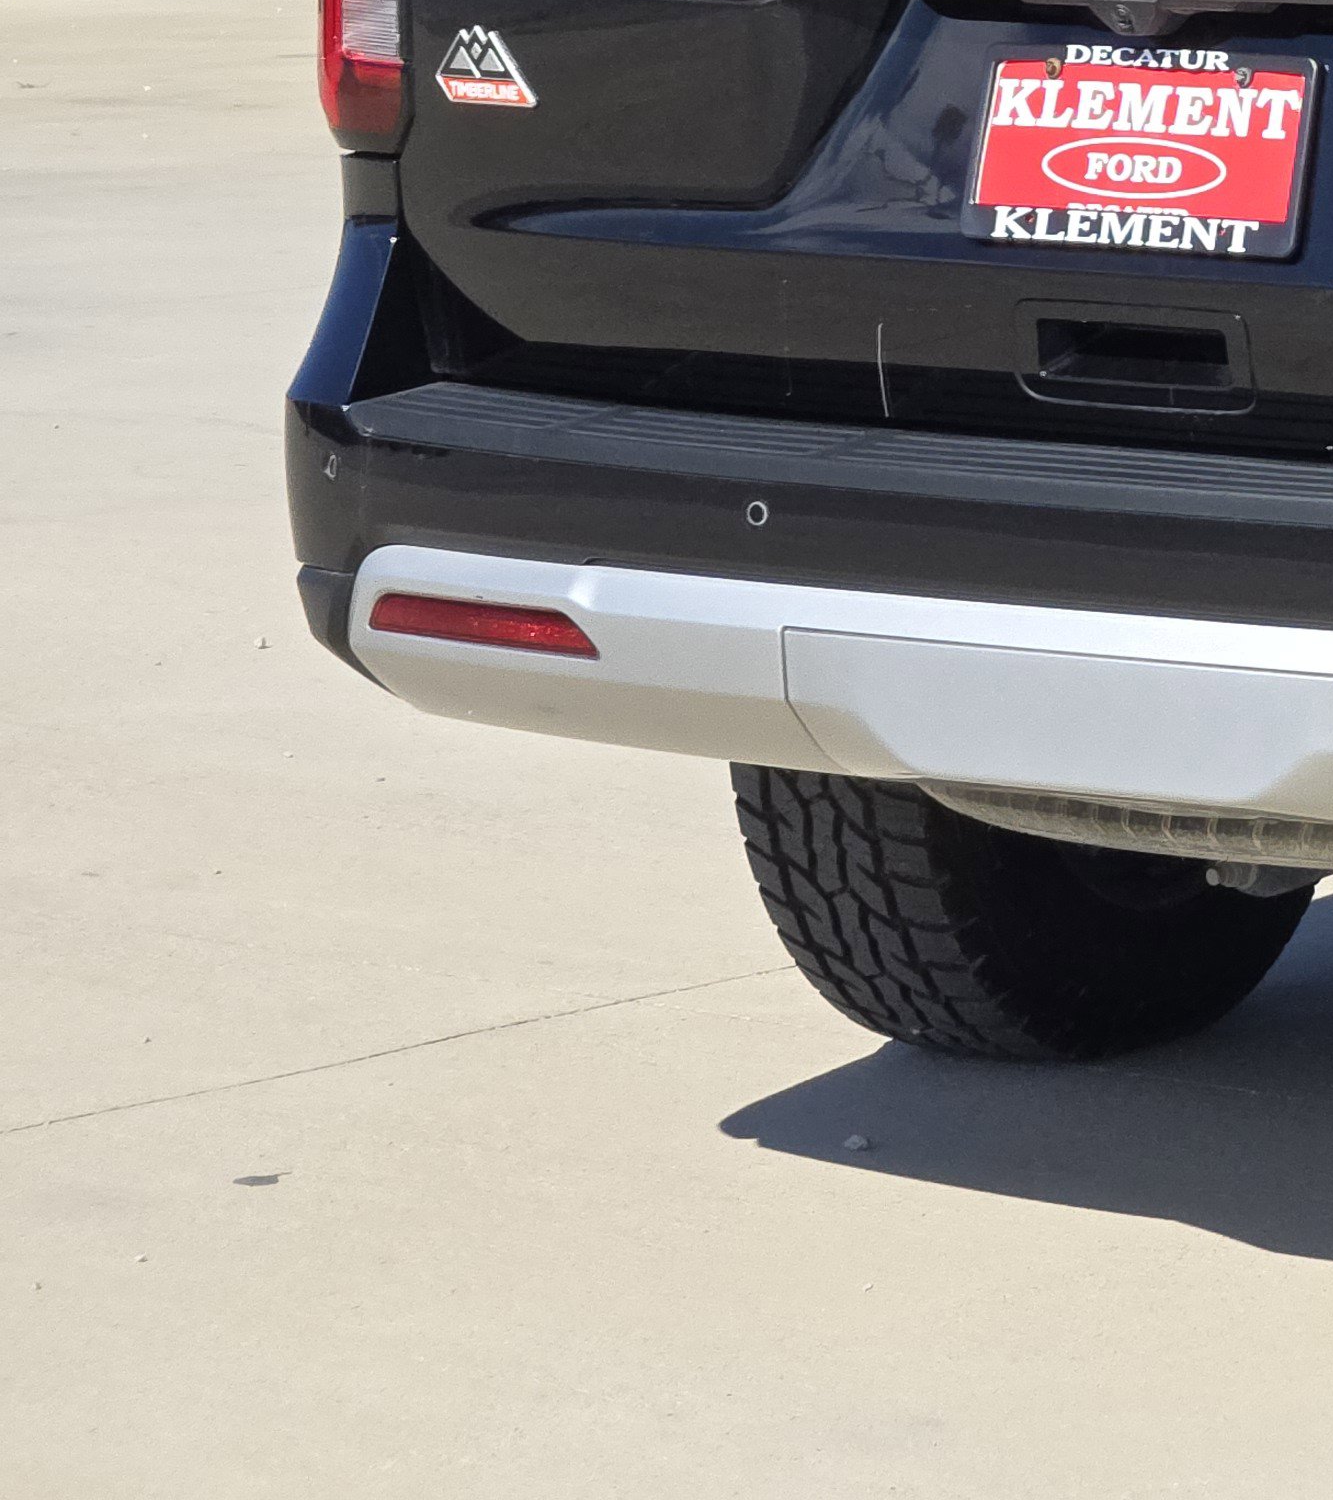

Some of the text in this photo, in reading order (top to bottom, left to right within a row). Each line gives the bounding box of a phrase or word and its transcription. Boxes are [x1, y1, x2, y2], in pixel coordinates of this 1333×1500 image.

[1064, 44, 1230, 72] DECATUR
[449, 81, 519, 100] TIMBERLINE
[992, 78, 1303, 140] KLEMENT
[1084, 152, 1182, 184] FORD
[990, 205, 1260, 254] KLEMENT
